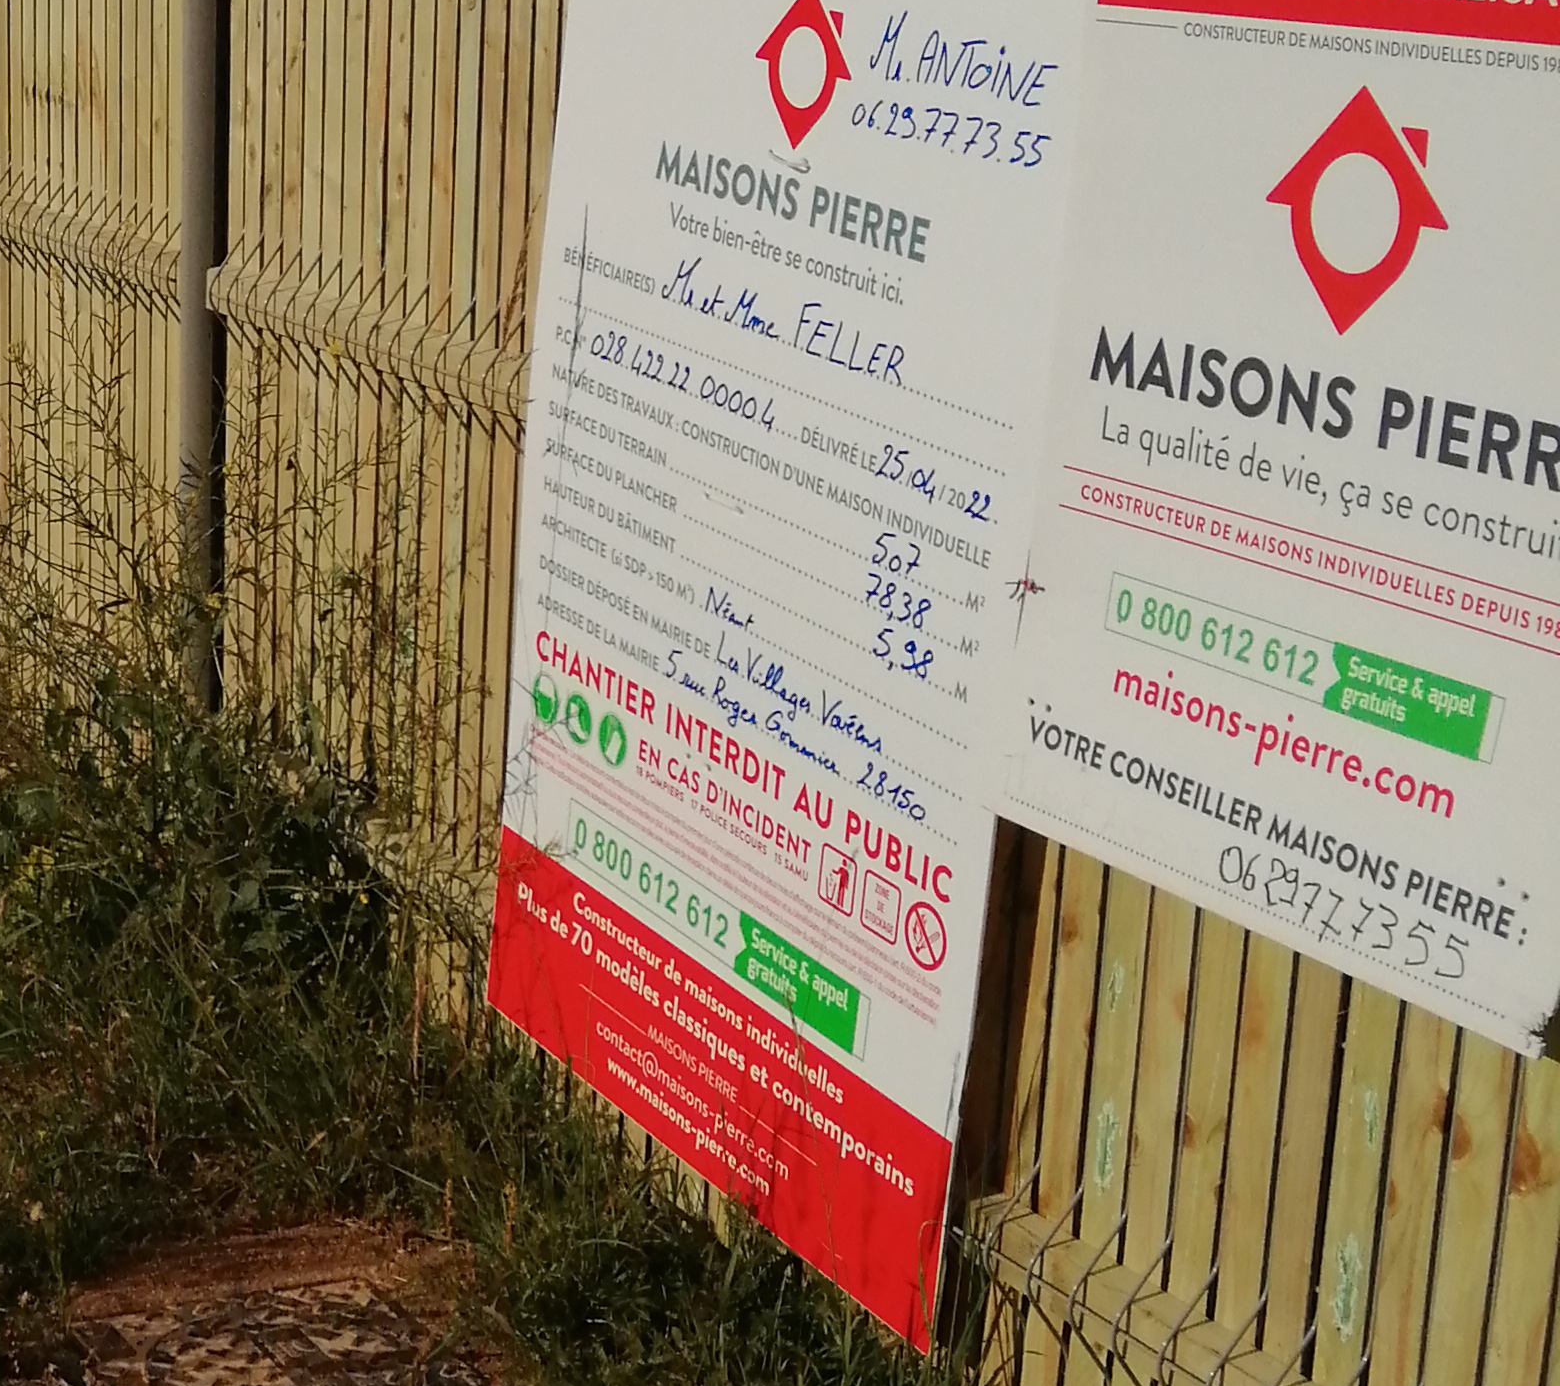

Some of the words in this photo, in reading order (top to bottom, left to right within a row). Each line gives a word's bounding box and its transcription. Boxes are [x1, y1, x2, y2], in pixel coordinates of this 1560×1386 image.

[1183, 22, 1286, 47] CONSTRUCTEUR
[1288, 31, 1308, 49] DE
[1309, 33, 1372, 55] MAISONS
[1374, 40, 1482, 67] INDIVIDUELLES
[1486, 51, 1539, 72] DEPUIS
[655, 141, 800, 221] MAISONS
[809, 185, 930, 263] PIERRE
[670, 201, 709, 240] Votre
[713, 215, 781, 264] bien-être
[785, 249, 802, 270] se
[805, 254, 877, 296] construit
[881, 269, 904, 305] ici.
[563, 246, 656, 295] BÉNÉFICIAIRE(S)
[631, 344, 664, 382] 422
[668, 362, 690, 392] 22
[700, 285, 725, 317] et
[794, 303, 905, 386] FELLER
[1090, 325, 1356, 439] MAISONS
[546, 438, 594, 473] SURFACE
[597, 462, 612, 481] DU
[615, 470, 678, 513] PLANCHER
[549, 401, 597, 435] SURFACE
[600, 423, 615, 443] DU
[619, 431, 667, 467] TERRAIN
[552, 363, 594, 395] NATURE
[598, 382, 618, 405] DES
[621, 393, 674, 430] TRAVAUX
[682, 420, 779, 476] CONSTRUCTION
[783, 462, 823, 496] D'UNE
[827, 482, 883, 525] MAISON
[887, 509, 991, 569] INDIVIDUELLE
[801, 426, 858, 466] DÉLIVRÉ
[861, 453, 877, 473] LE
[1102, 405, 1129, 445] La
[1140, 425, 1230, 471] qualité
[1239, 442, 1272, 482] de
[1282, 455, 1328, 506] vie,
[1340, 479, 1370, 517] ça
[1382, 489, 1413, 519] se
[1424, 497, 1560, 559] construi
[542, 514, 607, 559] ARCHITECTE
[624, 556, 646, 578] SDP
[656, 571, 674, 593] 150
[544, 476, 595, 515] HAUTEUR
[598, 503, 615, 523] DU
[617, 512, 676, 554] BÂTIMENT
[872, 533, 921, 574] 507
[1080, 483, 1205, 534] CONSTRUCTEUR
[1210, 518, 1231, 541] DE
[1236, 528, 1313, 564] MAISONS
[1318, 550, 1455, 608] INDIVIDUELLES
[1460, 592, 1531, 629] DEPUIS
[537, 593, 584, 630] ADRESSE
[586, 618, 601, 637] DE
[603, 627, 617, 648] LA
[619, 637, 660, 673] MAIRIE
[539, 555, 585, 591] DOSSIER
[587, 579, 630, 616] DÉPOSÉ
[633, 604, 649, 624] EN
[650, 613, 692, 648] MAIRIE
[694, 637, 711, 659] DE
[1115, 589, 1133, 623] 0
[1140, 596, 1191, 643] 800
[1200, 617, 1254, 665] 612
[1262, 638, 1319, 688] 612
[665, 649, 683, 678] 5
[857, 762, 925, 821] 28150
[954, 682, 967, 703] M
[1341, 685, 1406, 723] gratuits
[1347, 656, 1409, 695] Service
[1410, 677, 1424, 697] &
[1428, 681, 1476, 718] appel
[536, 630, 655, 726] CHANTIER
[666, 702, 785, 800] INTERDIT
[793, 782, 834, 830] AU
[844, 809, 953, 904] PUBLIC
[1113, 667, 1456, 819] maisons-pierre.com
[638, 738, 661, 770] EN
[667, 757, 700, 794] CAS
[706, 779, 812, 864] D'INCIDENT
[645, 768, 684, 802] POMPIERS
[700, 804, 728, 831] POLICE
[730, 823, 767, 856] SECOURS
[784, 858, 809, 882] SAMU
[1030, 714, 1105, 770] VOTRE
[1110, 749, 1263, 836] CONSEILLER
[1266, 814, 1399, 891] MAISONS
[575, 818, 587, 850] 0
[593, 830, 632, 881] 800
[639, 862, 679, 915] 612
[686, 894, 729, 950] 612
[573, 892, 662, 970] Constructeur
[664, 958, 682, 985] de
[684, 976, 744, 1031] maisons
[746, 1015, 844, 1105] individuelles
[746, 956, 798, 1003] gratuits
[751, 928, 797, 972] Service
[799, 961, 810, 985] &
[812, 972, 848, 1012] appel
[518, 882, 547, 924] Plus
[550, 911, 568, 940] de
[569, 923, 594, 957] 70
[595, 950, 660, 1008] modèles
[663, 995, 746, 1072] classiques
[750, 1063, 769, 1090] et
[772, 1081, 914, 1197] contemporains
[647, 1024, 697, 1073] MAISONS
[698, 1064, 738, 1103] PIERRE
[596, 1022, 789, 1180] contact@maisons-pierre.com
[607, 1058, 770, 1196] www.maisons-pierre.com
